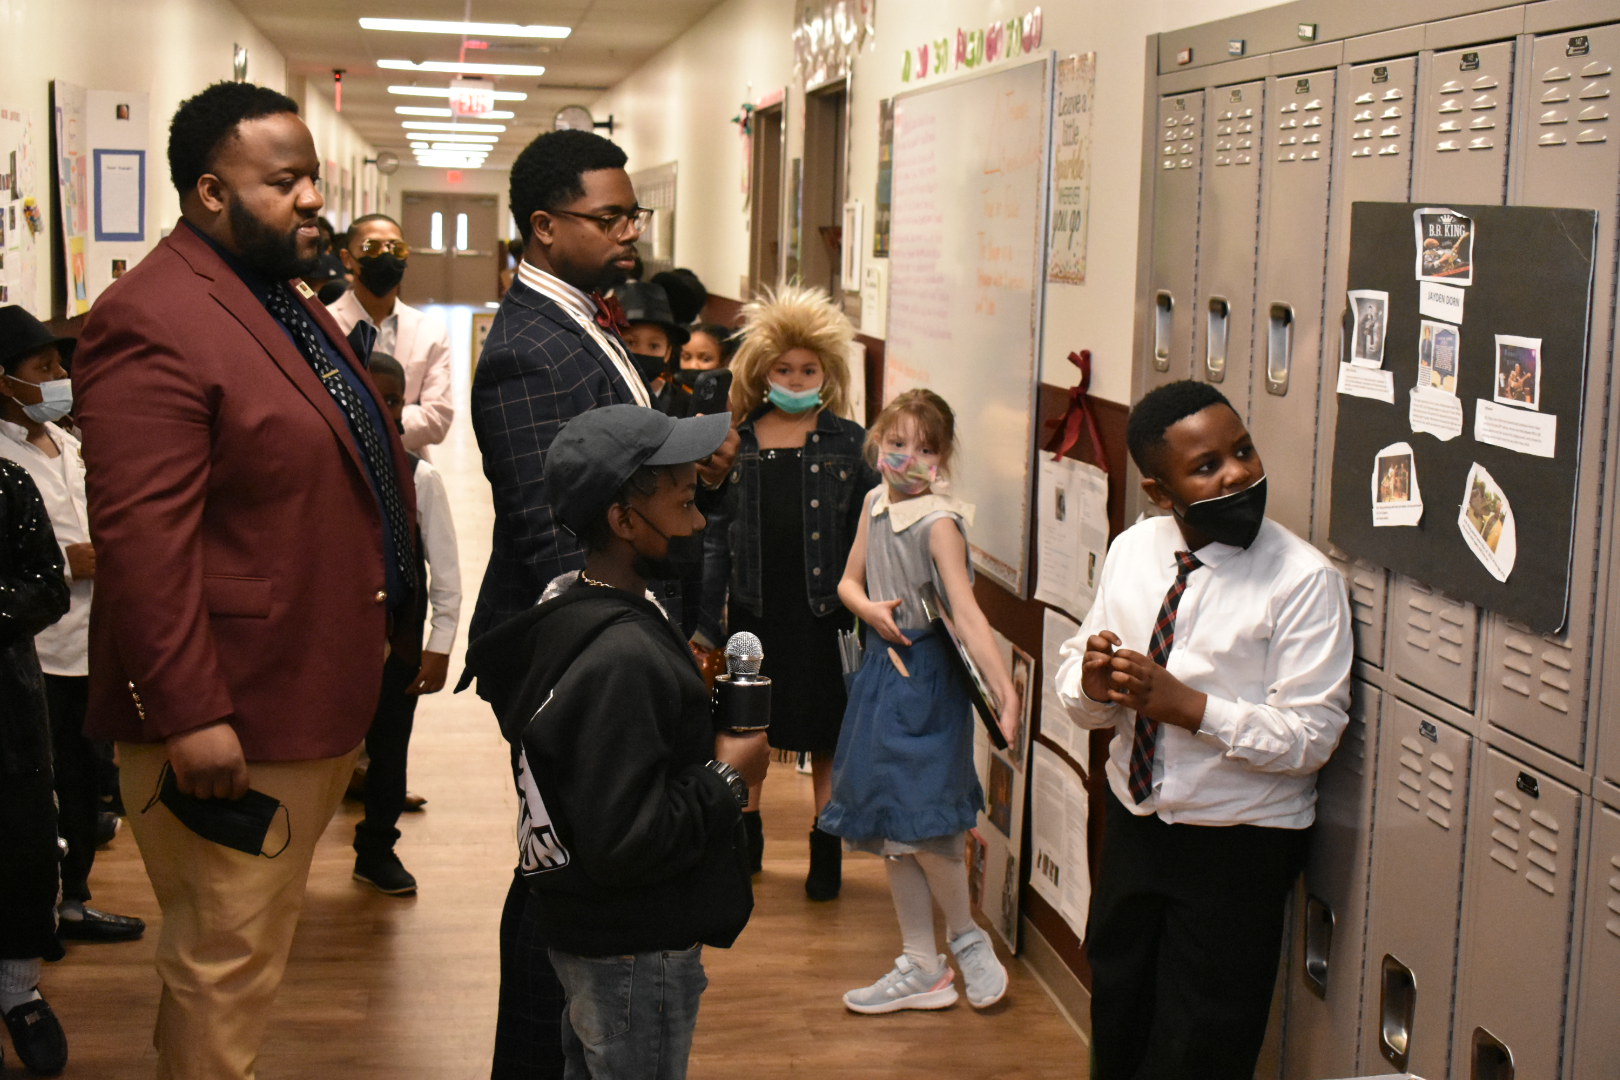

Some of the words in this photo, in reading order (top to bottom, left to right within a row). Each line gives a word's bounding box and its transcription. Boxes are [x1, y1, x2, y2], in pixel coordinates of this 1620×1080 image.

[1058, 92, 1081, 117] Leave
[1081, 94, 1088, 113] a
[1051, 210, 1068, 249] you
[1068, 209, 1081, 251] go
[1444, 223, 1466, 237] KING
[1428, 291, 1446, 303] JAYDEN
[1446, 295, 1460, 307] DORN
